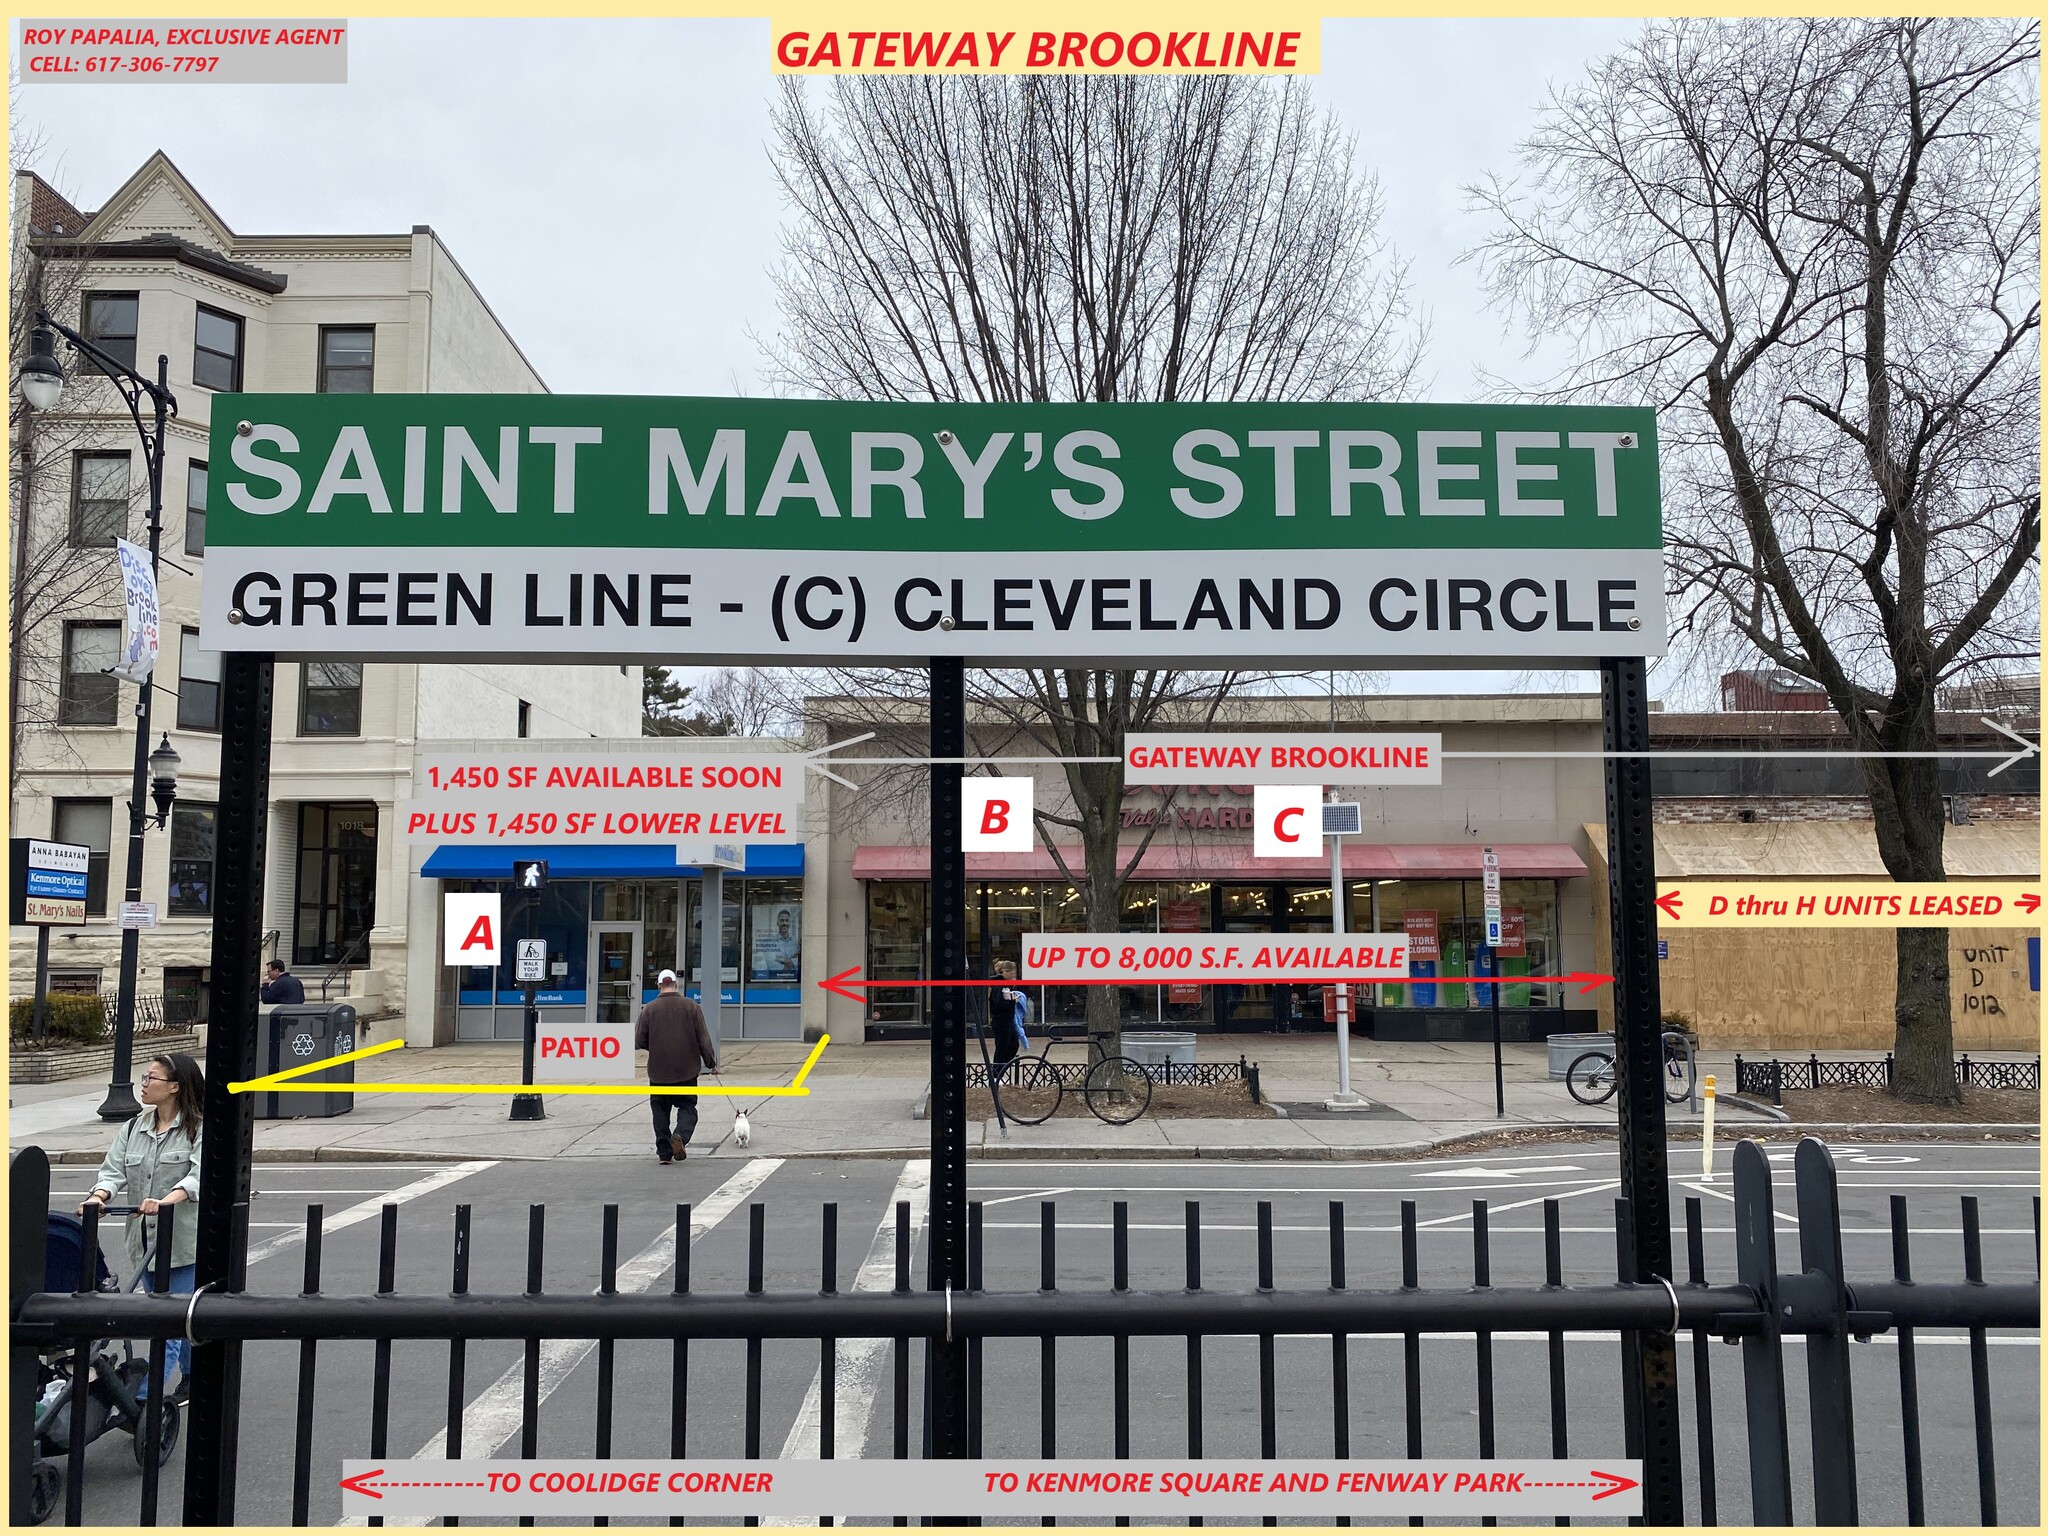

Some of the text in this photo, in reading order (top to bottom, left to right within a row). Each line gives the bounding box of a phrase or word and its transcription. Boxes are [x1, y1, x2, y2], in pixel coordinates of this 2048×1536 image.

[226, 423, 1640, 521] SAINT MARY'S STREET
[230, 572, 1640, 642] GREEN LINE - (C) CLEVELAND CIRCLE
[340, 821, 364, 830] 1018
[1120, 807, 1172, 829] Vale
[32, 847, 86, 860] ANNA BABAYAN
[31, 872, 85, 888] Kenmore Optical
[28, 903, 83, 919] St. Mary's Nails
[1409, 937, 1435, 945] STORE
[1972, 968, 1984, 987] D
[1963, 993, 2006, 1016] 1012
